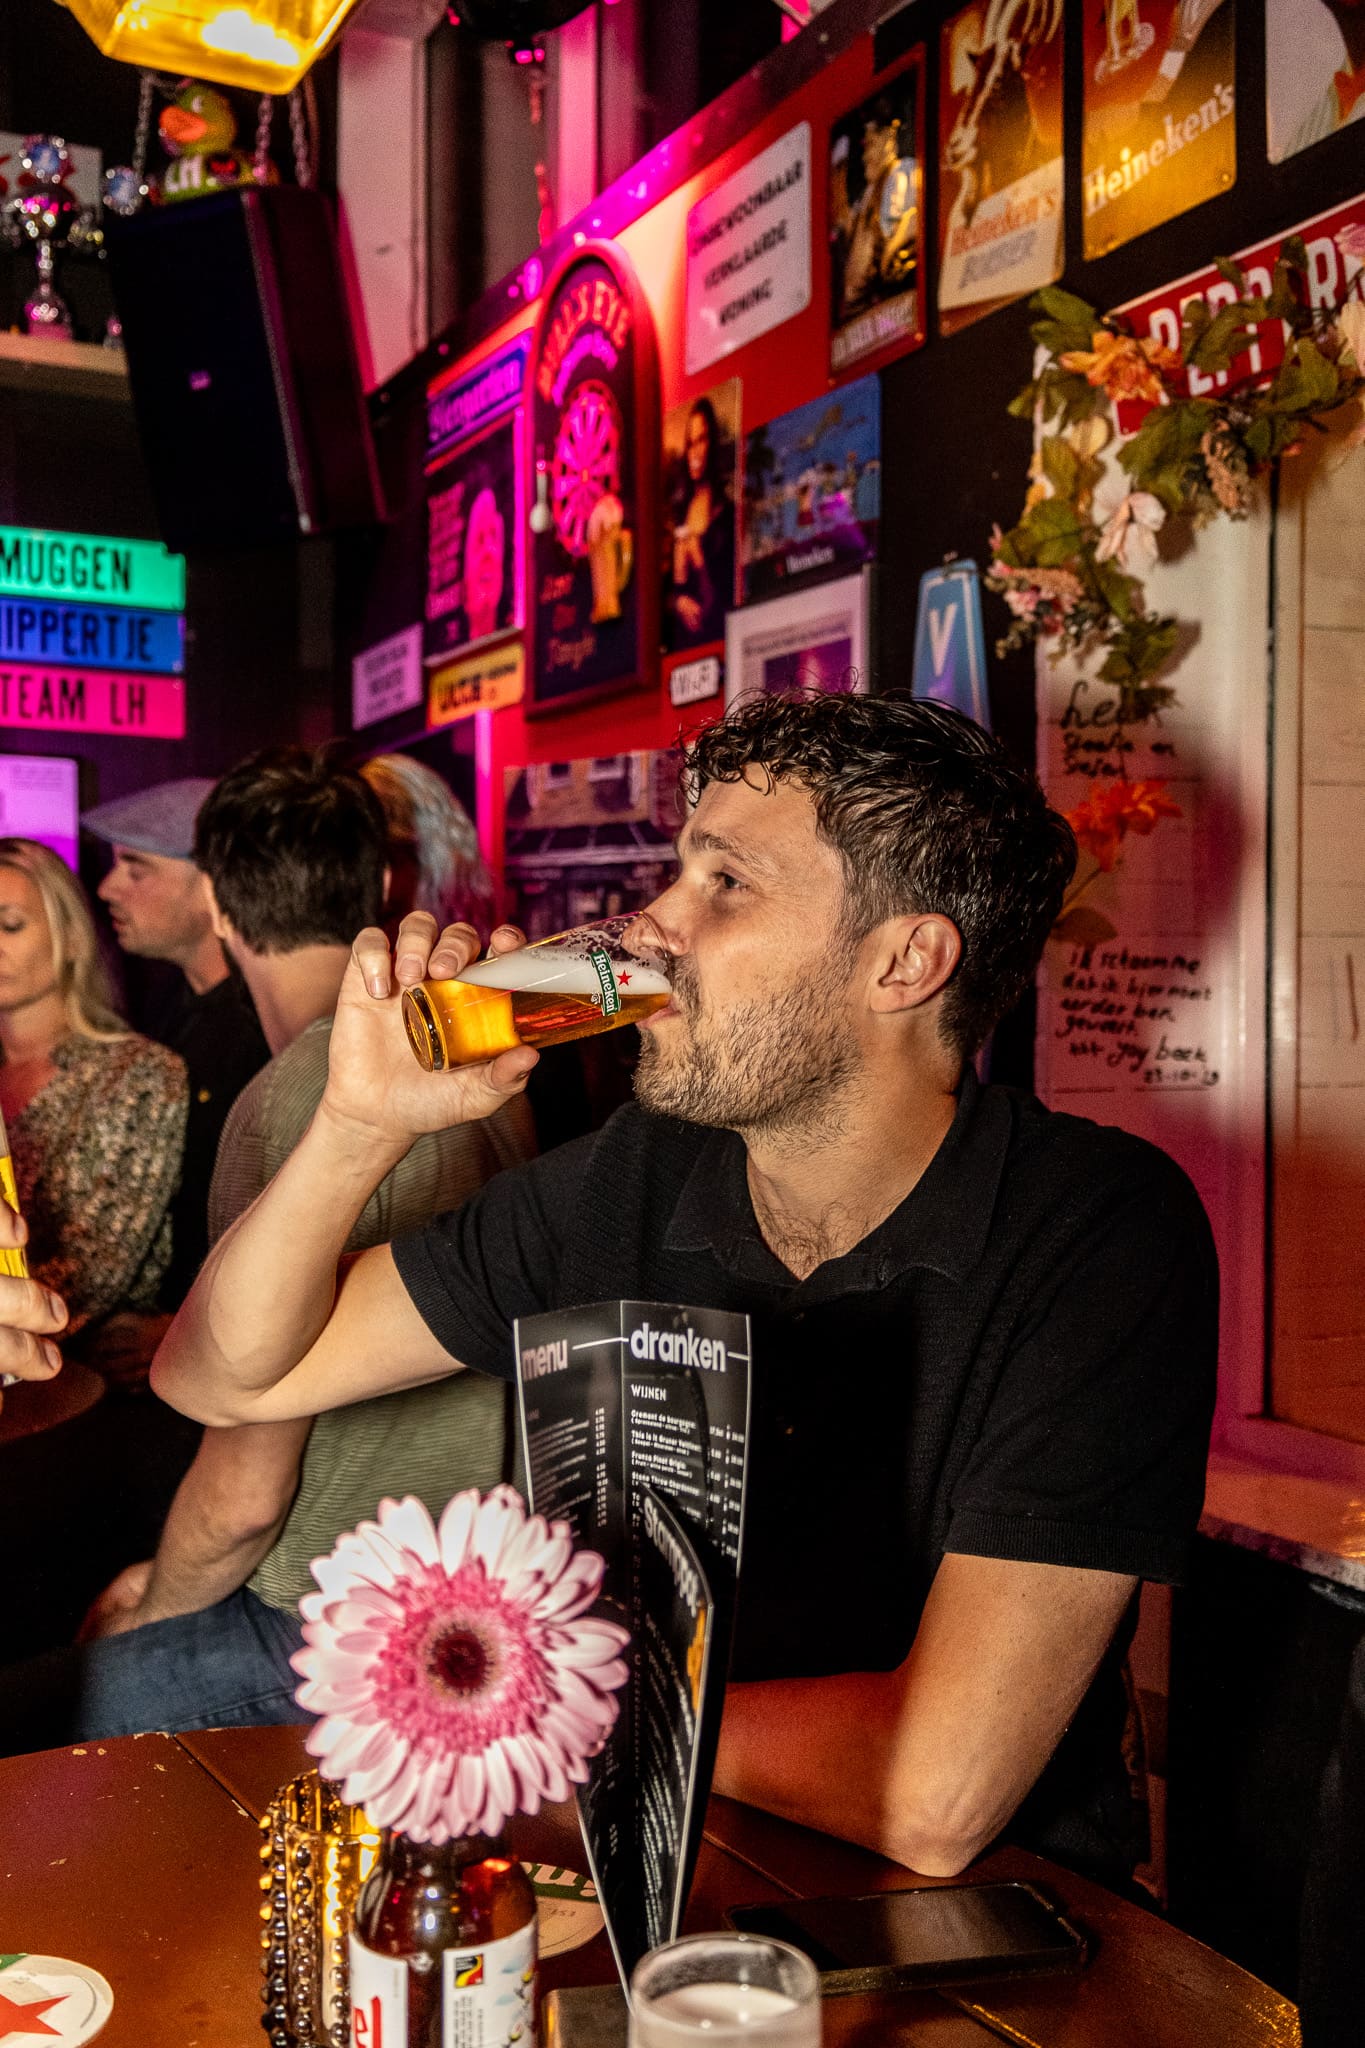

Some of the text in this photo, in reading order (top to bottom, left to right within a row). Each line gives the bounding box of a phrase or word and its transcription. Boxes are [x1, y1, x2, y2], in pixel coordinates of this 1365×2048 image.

[1083, 82, 1235, 216] Heineken's
[0, 536, 131, 593] MUGGEN
[0, 606, 155, 662] IPPERTJE
[0, 673, 147, 725] TEAM LH
[594, 954, 615, 1012] Heineken
[522, 1339, 568, 1382] menu
[630, 1322, 727, 1373] dranken
[630, 1384, 667, 1401] WIJNEN
